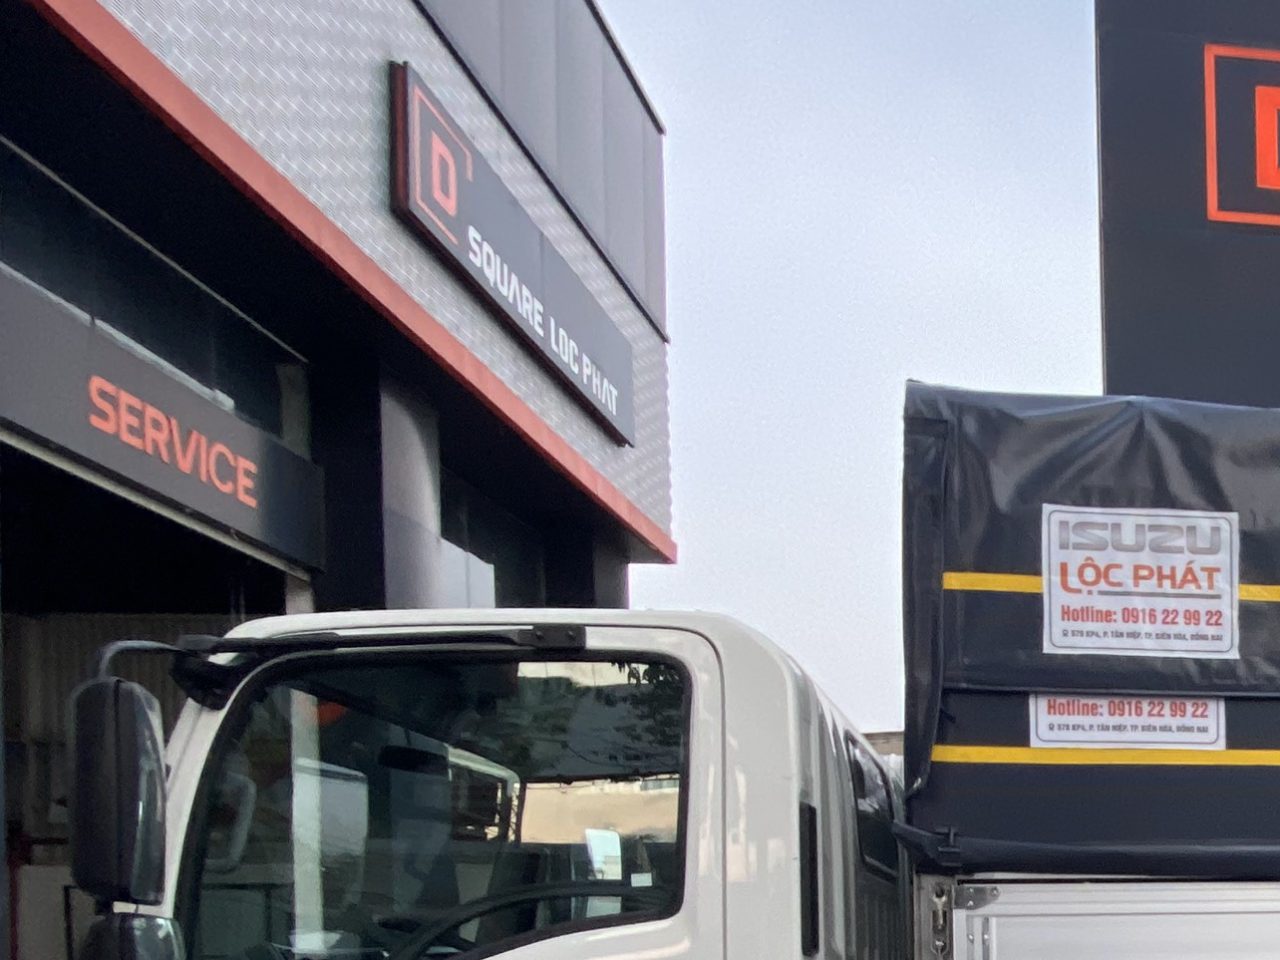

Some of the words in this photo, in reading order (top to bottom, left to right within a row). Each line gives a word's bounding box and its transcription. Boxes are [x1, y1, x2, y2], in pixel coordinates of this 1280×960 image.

[467, 224, 544, 338] SQUARE
[549, 315, 580, 375] LOC
[582, 351, 619, 416] PHAT
[88, 374, 258, 509] SERVICE
[1058, 520, 1222, 555] ISUZU
[1060, 556, 1124, 596] LỘC
[1132, 559, 1222, 591] PHÁT
[1061, 604, 1117, 623] Hotline:
[1121, 607, 1157, 625] 0916
[1161, 608, 1179, 625] 22
[1183, 609, 1201, 626] 99
[1205, 610, 1223, 626] 22
[1046, 698, 1104, 717] Hotline:
[1108, 699, 1143, 717] 0916
[1147, 700, 1165, 718] 22
[1169, 701, 1187, 718] 99
[1191, 702, 1209, 719] 22
